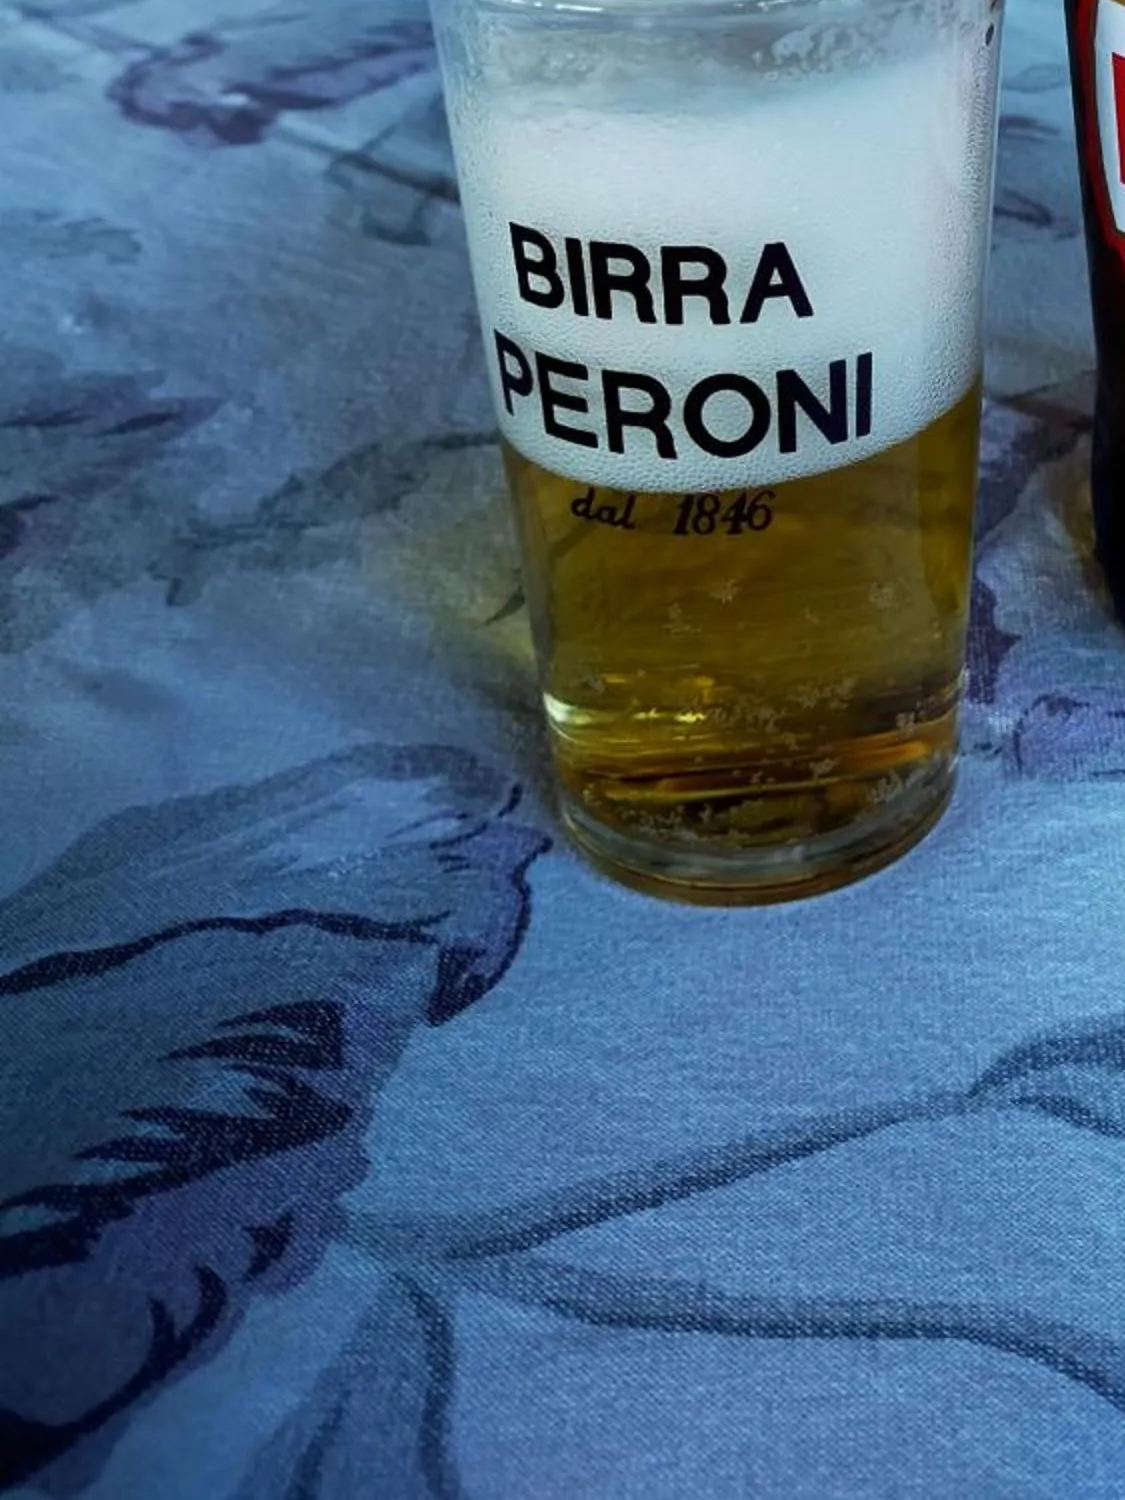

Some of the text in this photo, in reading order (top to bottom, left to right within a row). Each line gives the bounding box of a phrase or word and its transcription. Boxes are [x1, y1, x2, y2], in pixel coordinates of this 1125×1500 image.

[509, 222, 814, 325] BIRRA
[494, 329, 873, 459] PERONI
[571, 488, 776, 536] dal 1846
